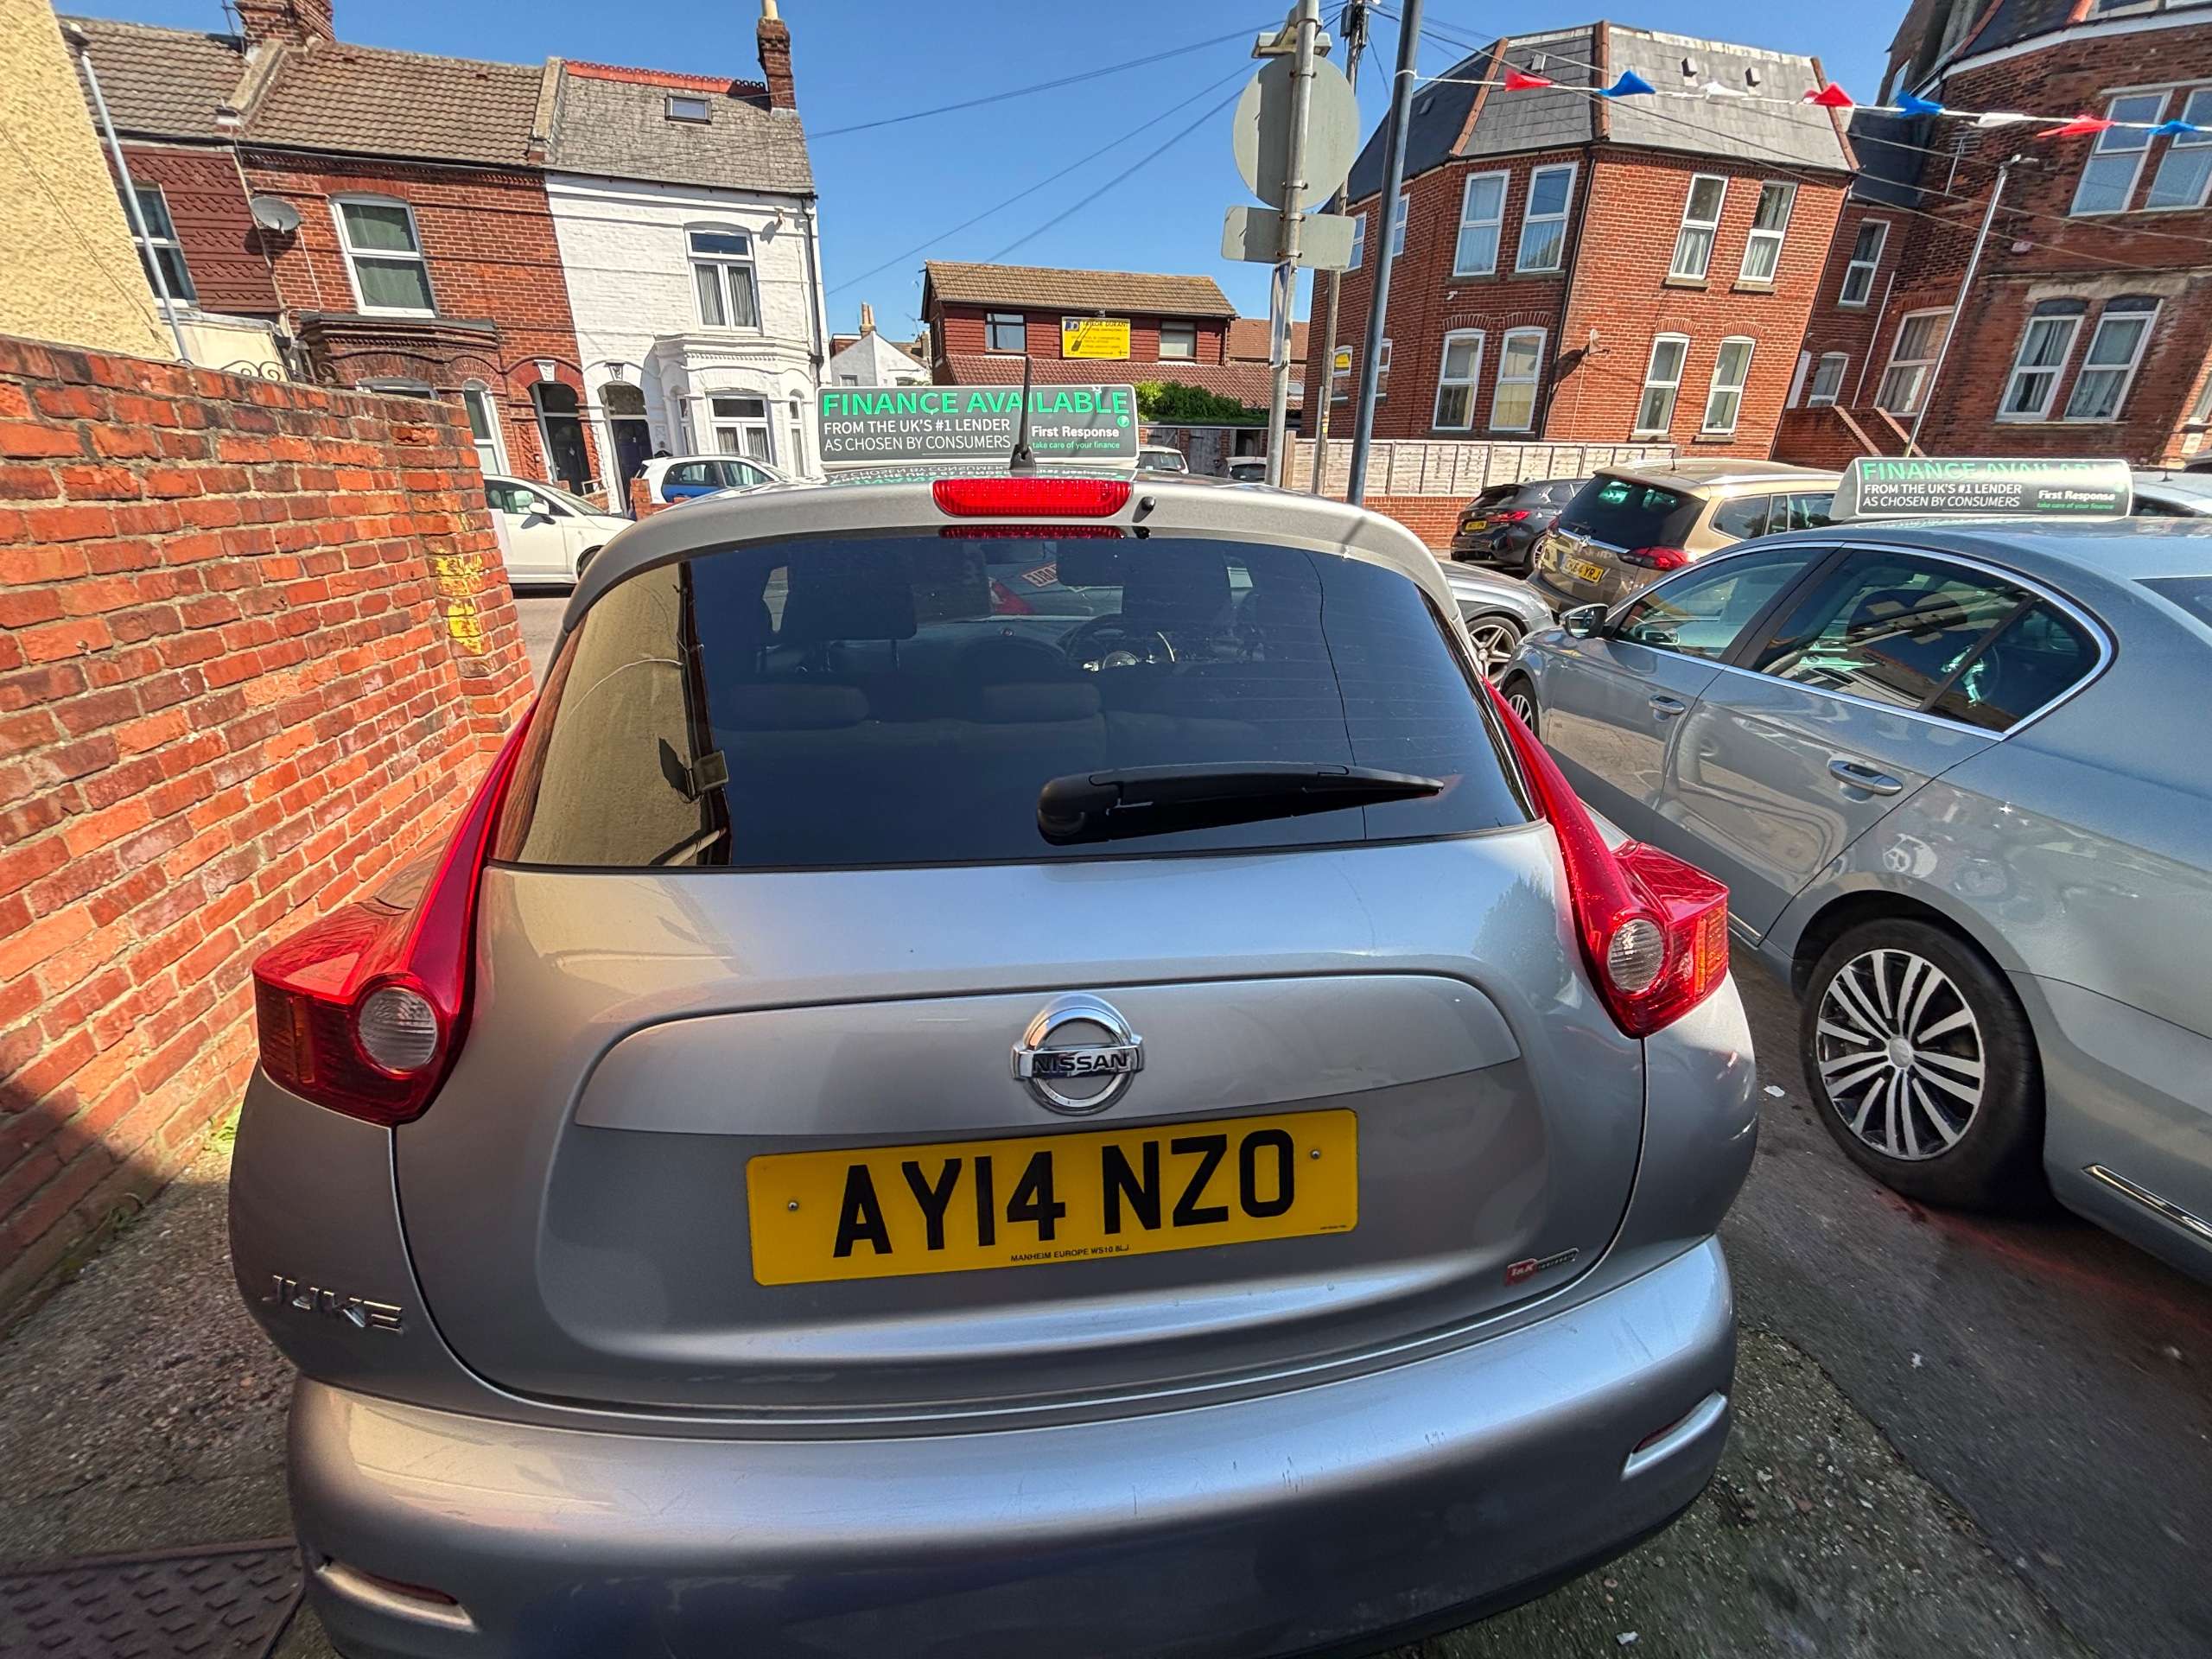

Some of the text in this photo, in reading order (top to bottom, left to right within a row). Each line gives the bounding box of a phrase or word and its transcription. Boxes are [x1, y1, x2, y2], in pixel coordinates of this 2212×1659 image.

[823, 391, 1130, 416] FINANCE AVAILABLE
[823, 418, 1010, 435] FROM THE UK'S #1 LENDER
[1032, 425, 1120, 439] First Response
[824, 435, 1011, 451] AS CHOSEN BY CONSUMERS
[1066, 441, 1075, 449] of
[1075, 442, 1092, 450] your
[1862, 463, 1975, 480] FINANCE
[1865, 484, 2022, 494] FROM THE UK'S #1 LENDER
[2038, 490, 2115, 501] First Response
[1863, 496, 2021, 507] AS CHOSEN BY CONSUMERS
[1584, 566, 1601, 581] YRJ
[1032, 1053, 1128, 1072] NISSAN
[832, 1128, 1295, 1258] AY14 NZO
[1011, 1251, 1052, 1262] MANHEIM
[1053, 1249, 1089, 1258] EUROPE
[1090, 1246, 1113, 1255] WS10
